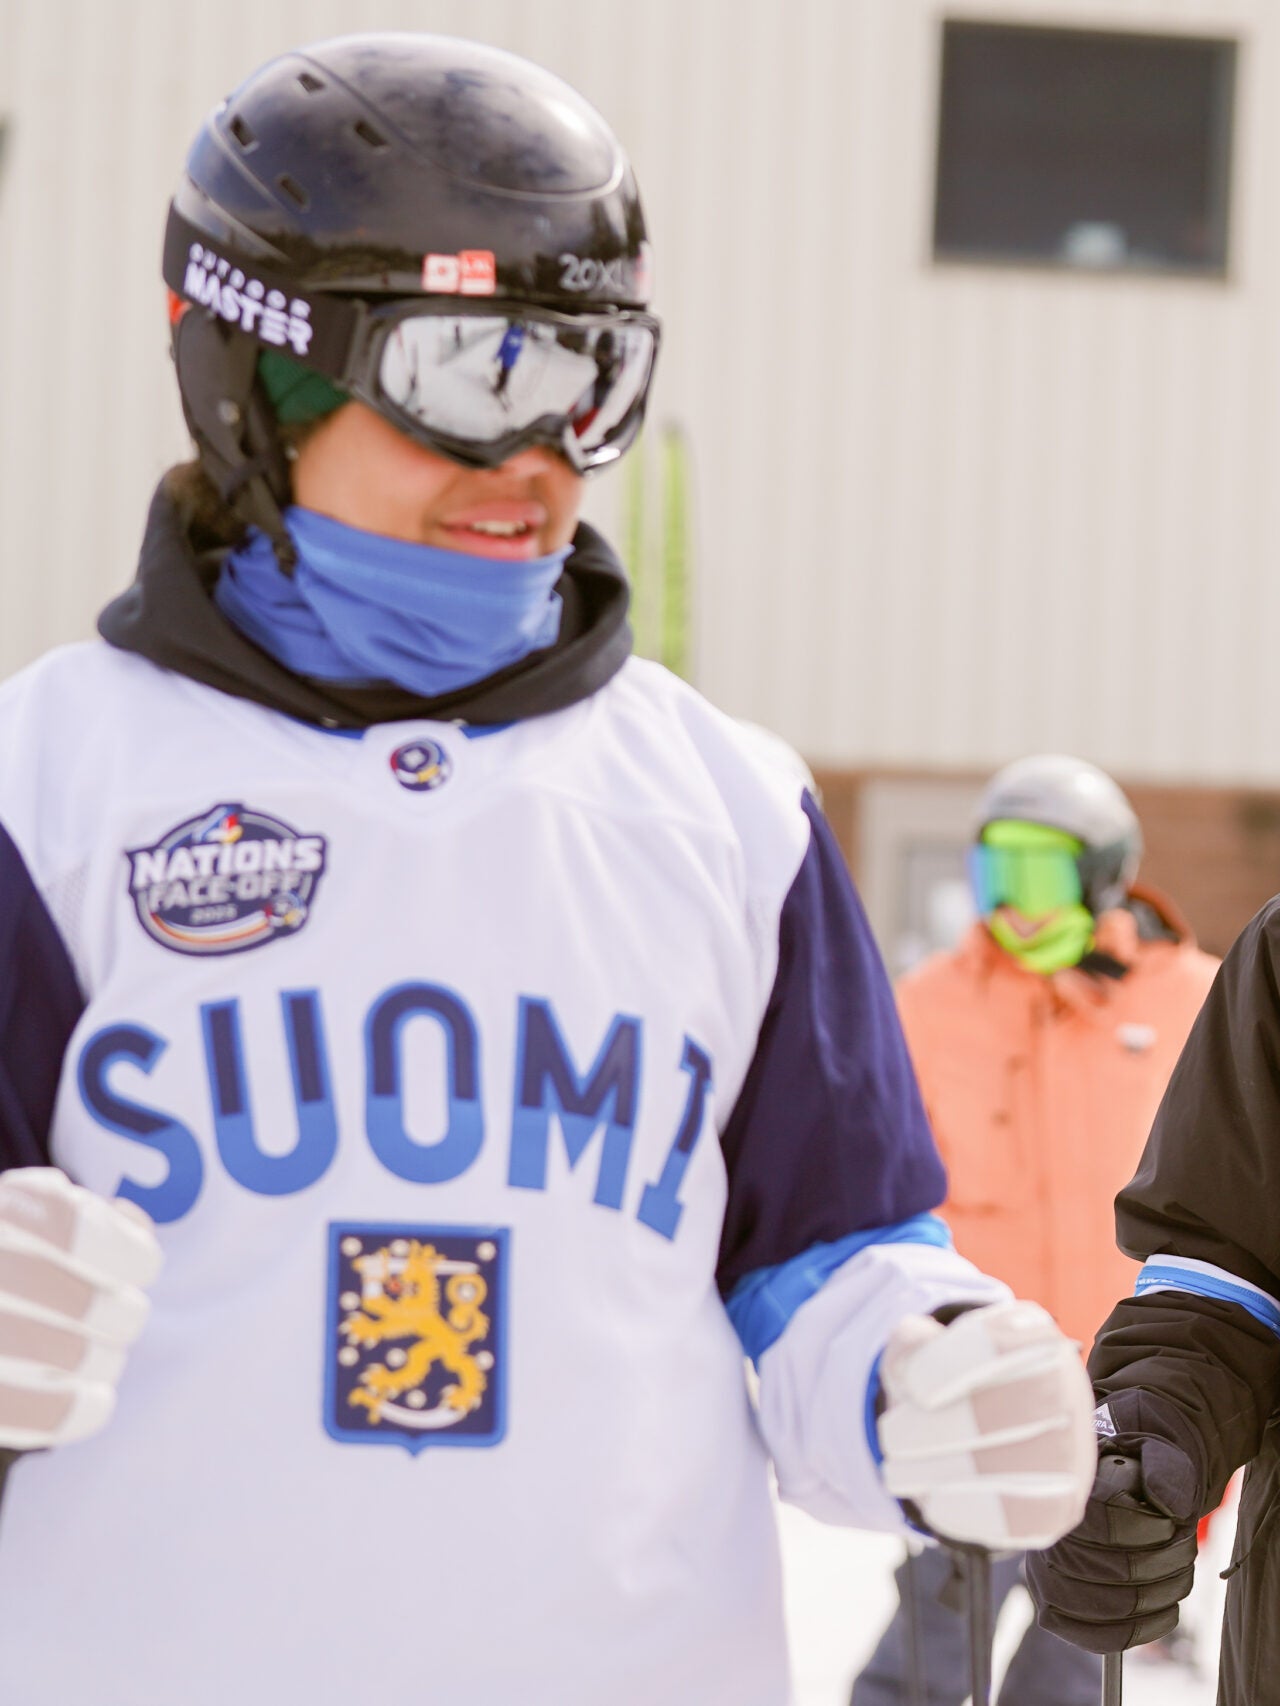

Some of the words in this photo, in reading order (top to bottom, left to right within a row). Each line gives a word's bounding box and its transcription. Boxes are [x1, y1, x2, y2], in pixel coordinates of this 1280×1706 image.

[184, 261, 313, 355] MASTER
[134, 838, 322, 887] NATIONS
[77, 979, 712, 1242] SUOMI
